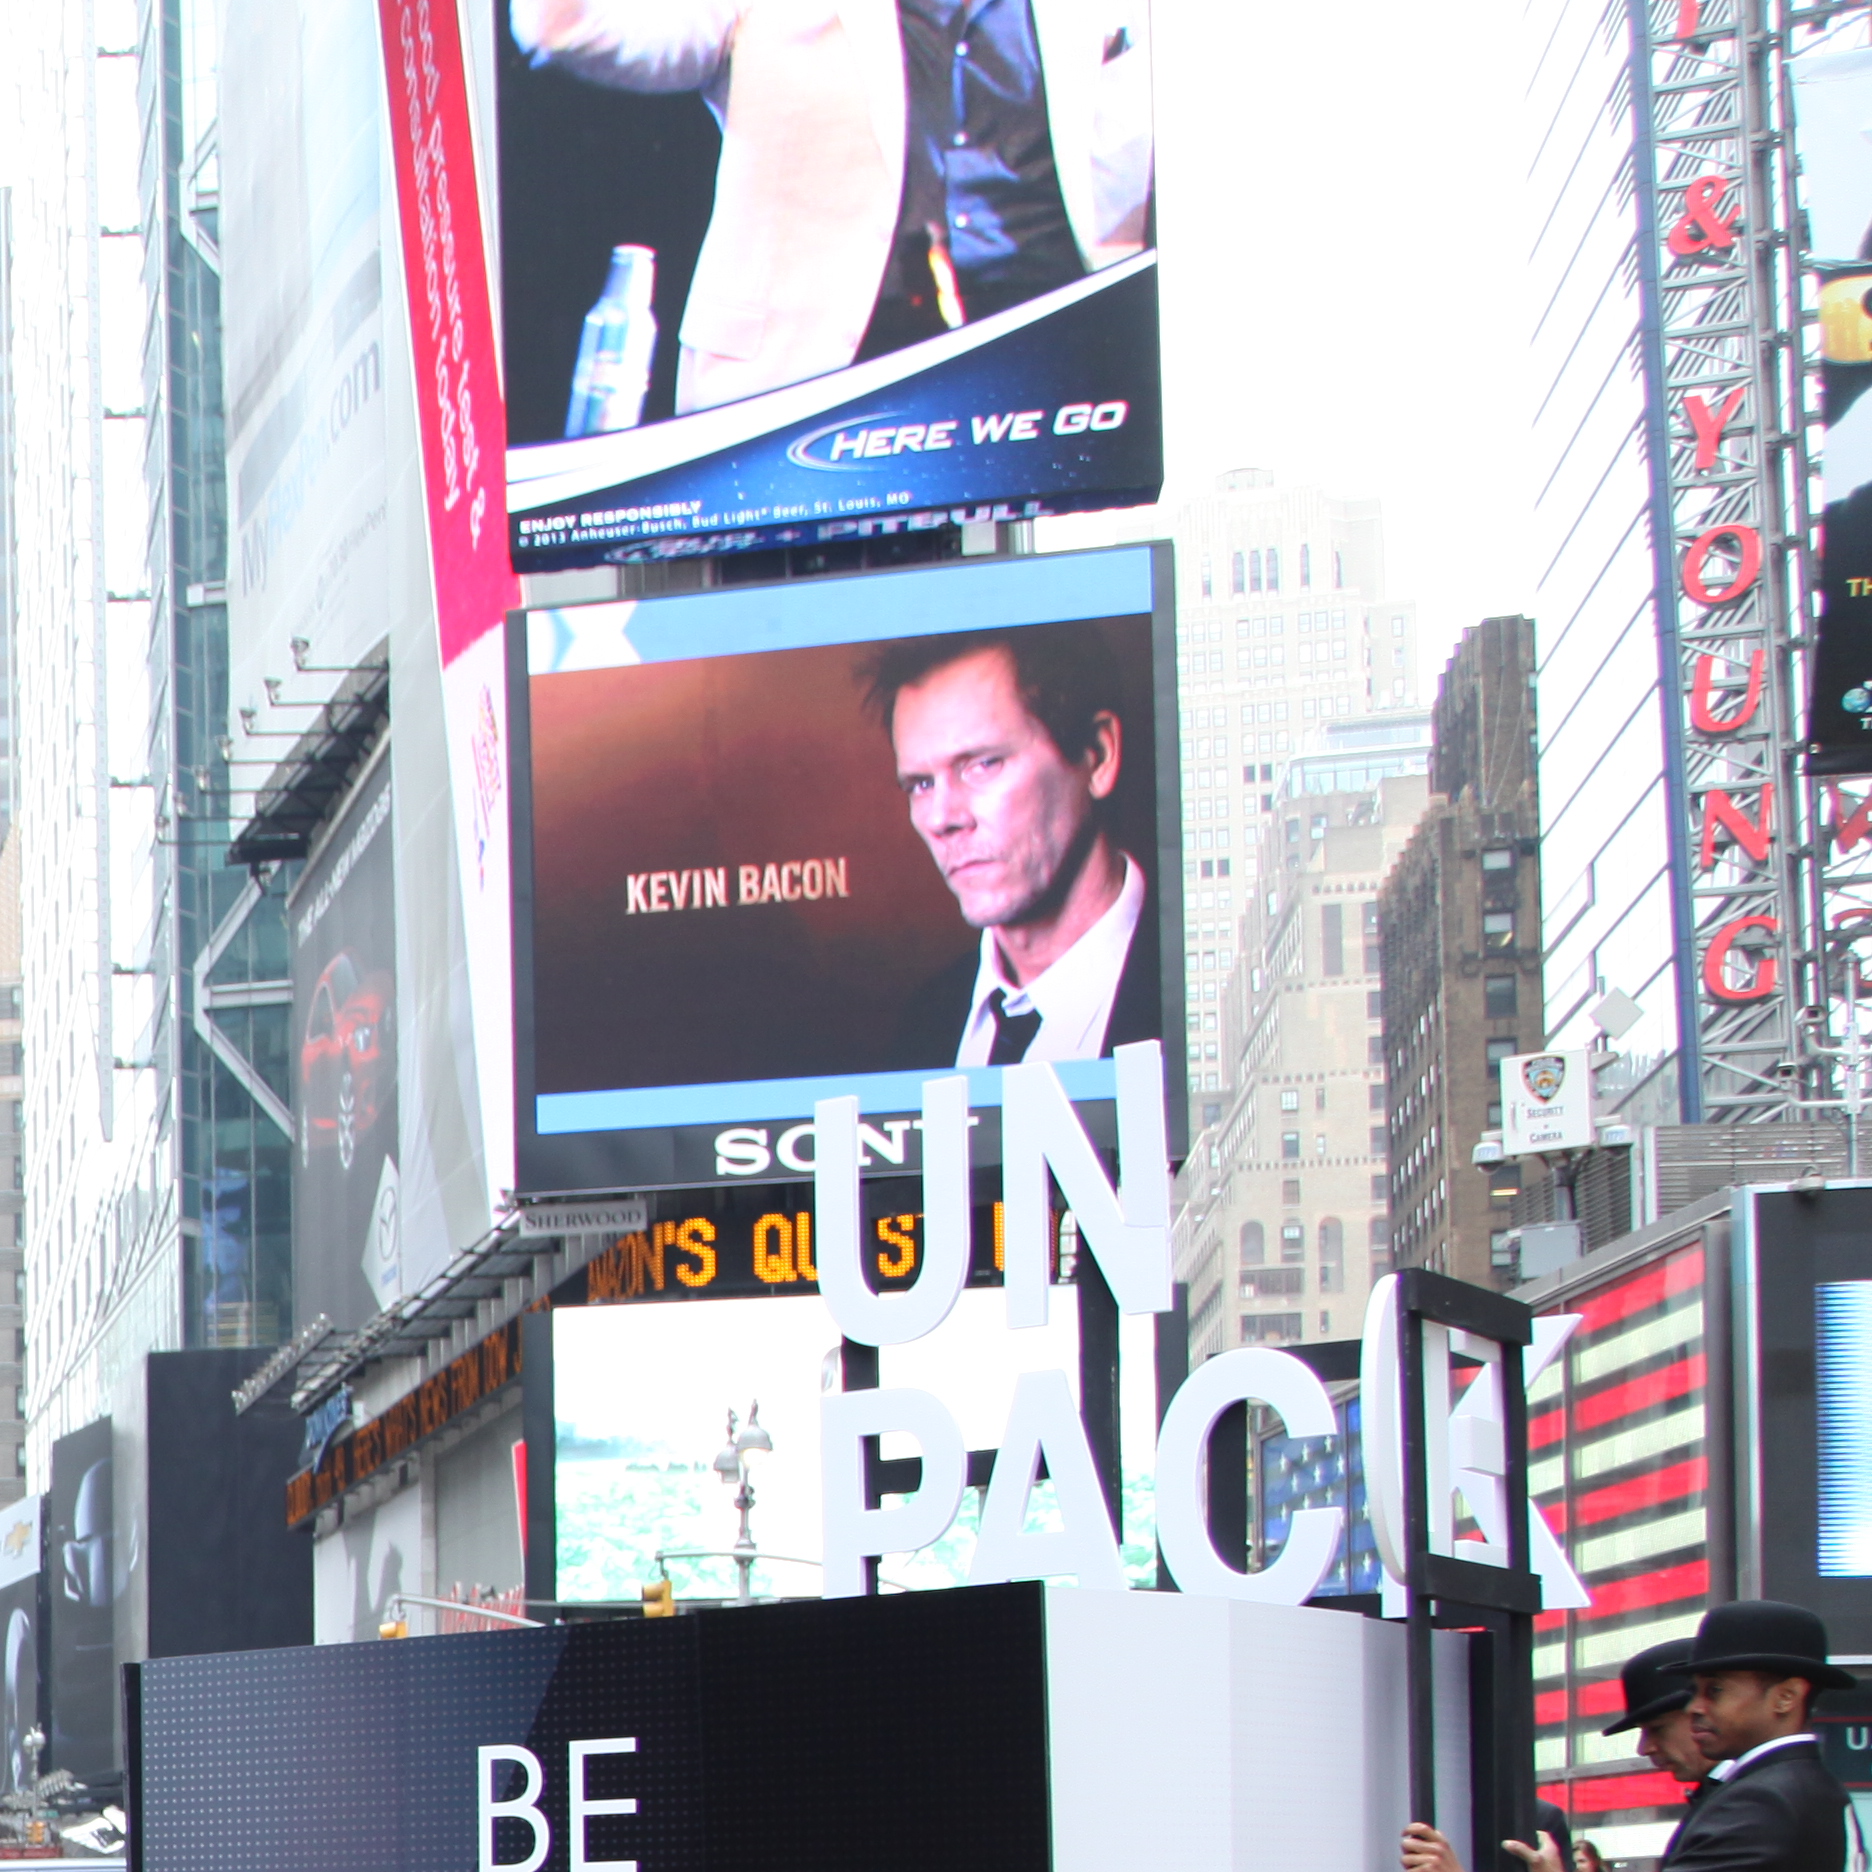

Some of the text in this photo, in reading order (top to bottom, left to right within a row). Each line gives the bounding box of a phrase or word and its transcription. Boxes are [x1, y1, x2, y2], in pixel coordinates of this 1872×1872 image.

[830, 401, 1128, 465] HERE WE GO
[519, 500, 702, 535] ENJOY RESPONSIBLY
[1683, 387, 1780, 1001] YOUNG
[626, 856, 849, 915] KEVIN BACON
[715, 1114, 981, 1176] SON
[524, 1205, 644, 1232] SHERWOOD
[815, 1038, 1173, 1346] UN
